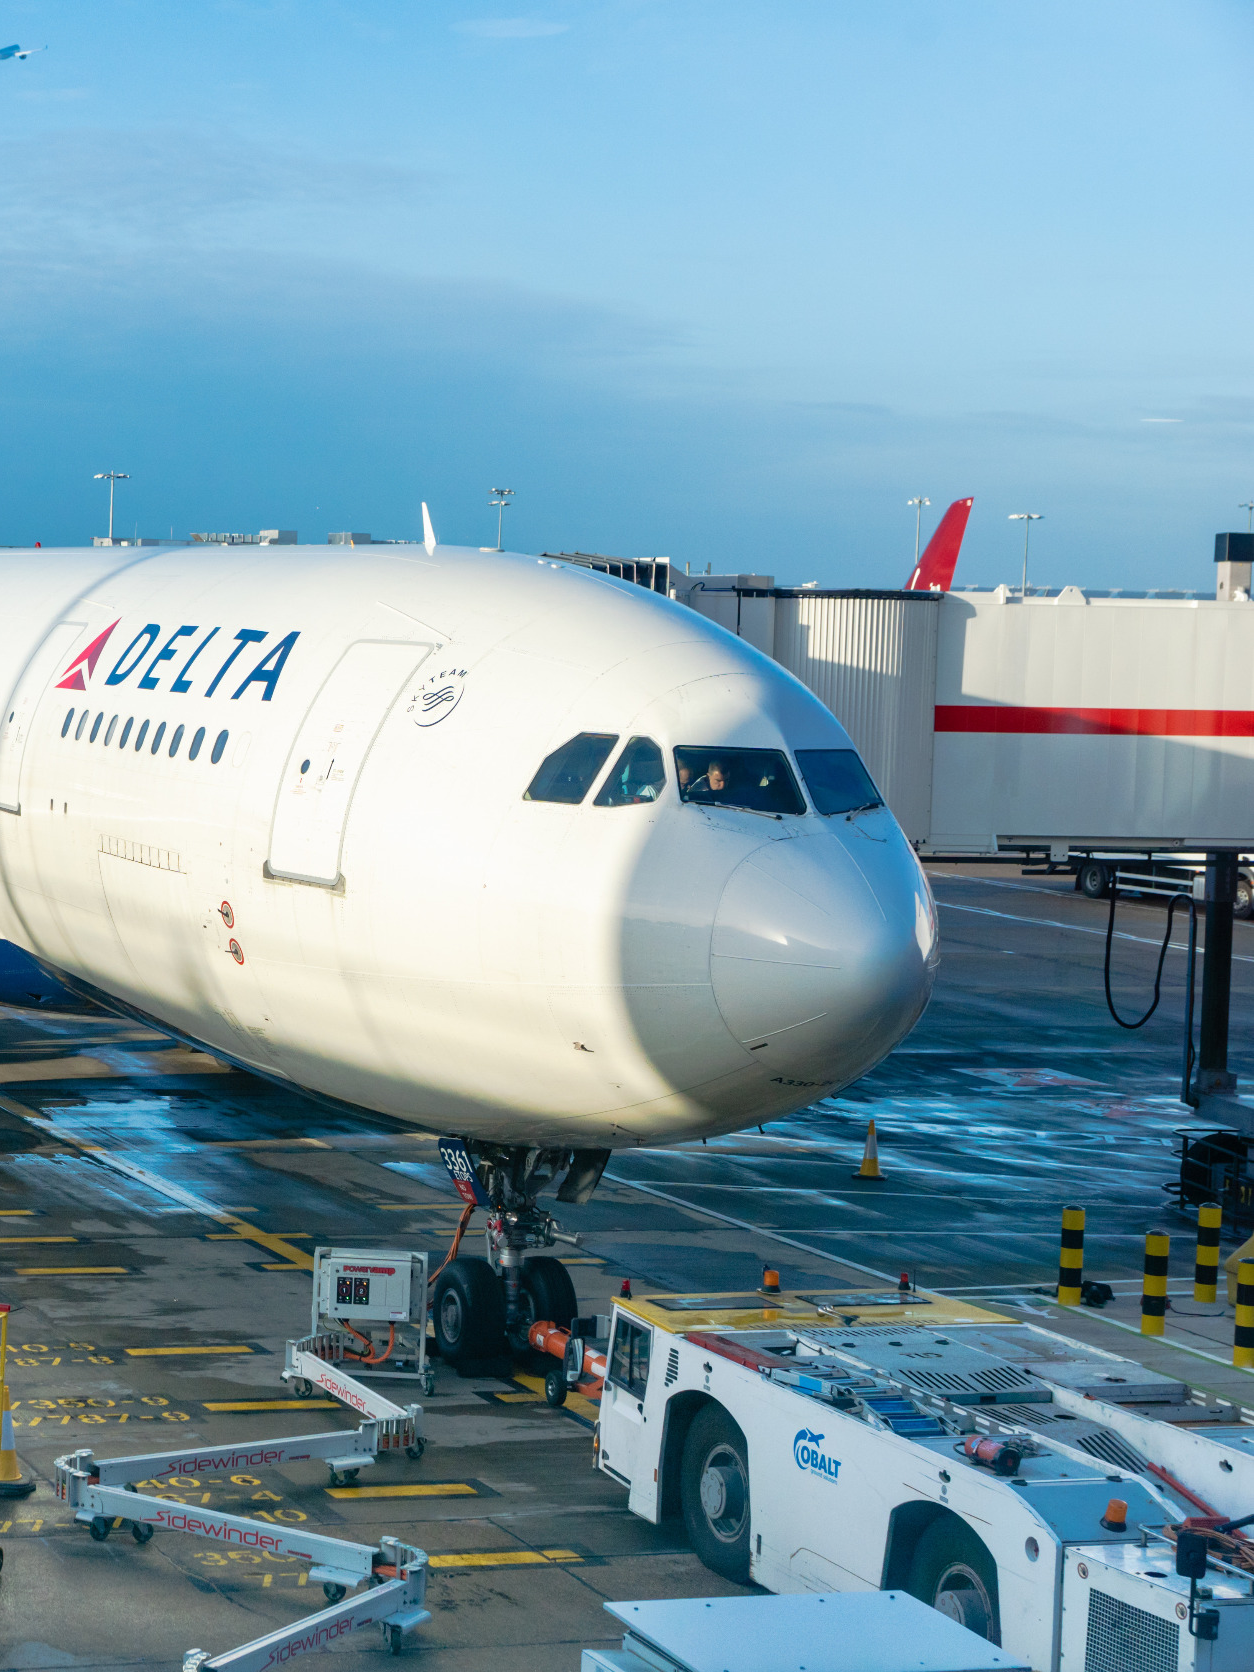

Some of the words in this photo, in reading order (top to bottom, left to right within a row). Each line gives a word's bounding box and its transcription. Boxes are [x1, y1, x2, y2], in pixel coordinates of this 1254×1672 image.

[104, 623, 301, 702] DELTA
[440, 1147, 474, 1173] 3361
[793, 1428, 842, 1478] COBALT
